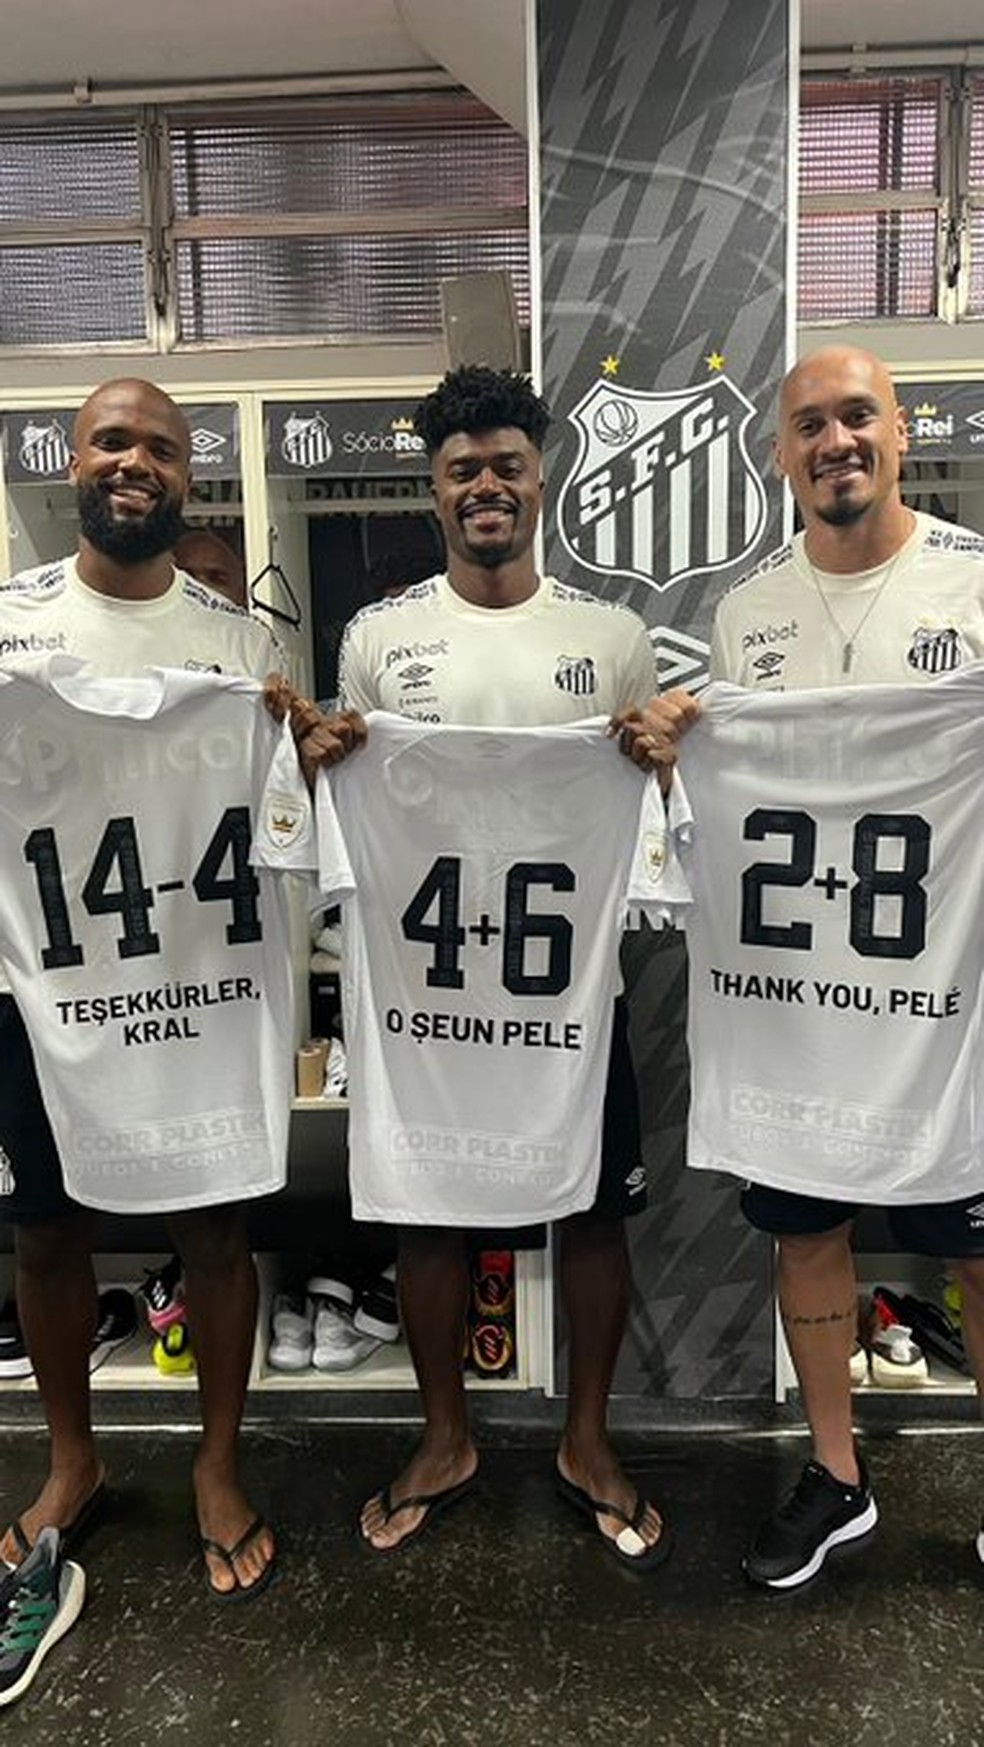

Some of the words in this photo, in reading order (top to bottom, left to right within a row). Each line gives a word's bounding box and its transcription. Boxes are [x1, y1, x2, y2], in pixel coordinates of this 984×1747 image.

[342, 430, 428, 454] SócioRe
[23, 805, 263, 970] 14-4
[740, 807, 932, 960] 2+8
[401, 855, 576, 997] 4+6
[56, 977, 262, 1027] TEŞEKKÜRLER,
[710, 967, 805, 1004] THANK
[813, 980, 880, 1016] YOU,
[888, 985, 962, 1019] PELÉ
[123, 1016, 201, 1047] KRAL
[386, 1008, 403, 1034] O
[502, 1020, 583, 1050] PELE
